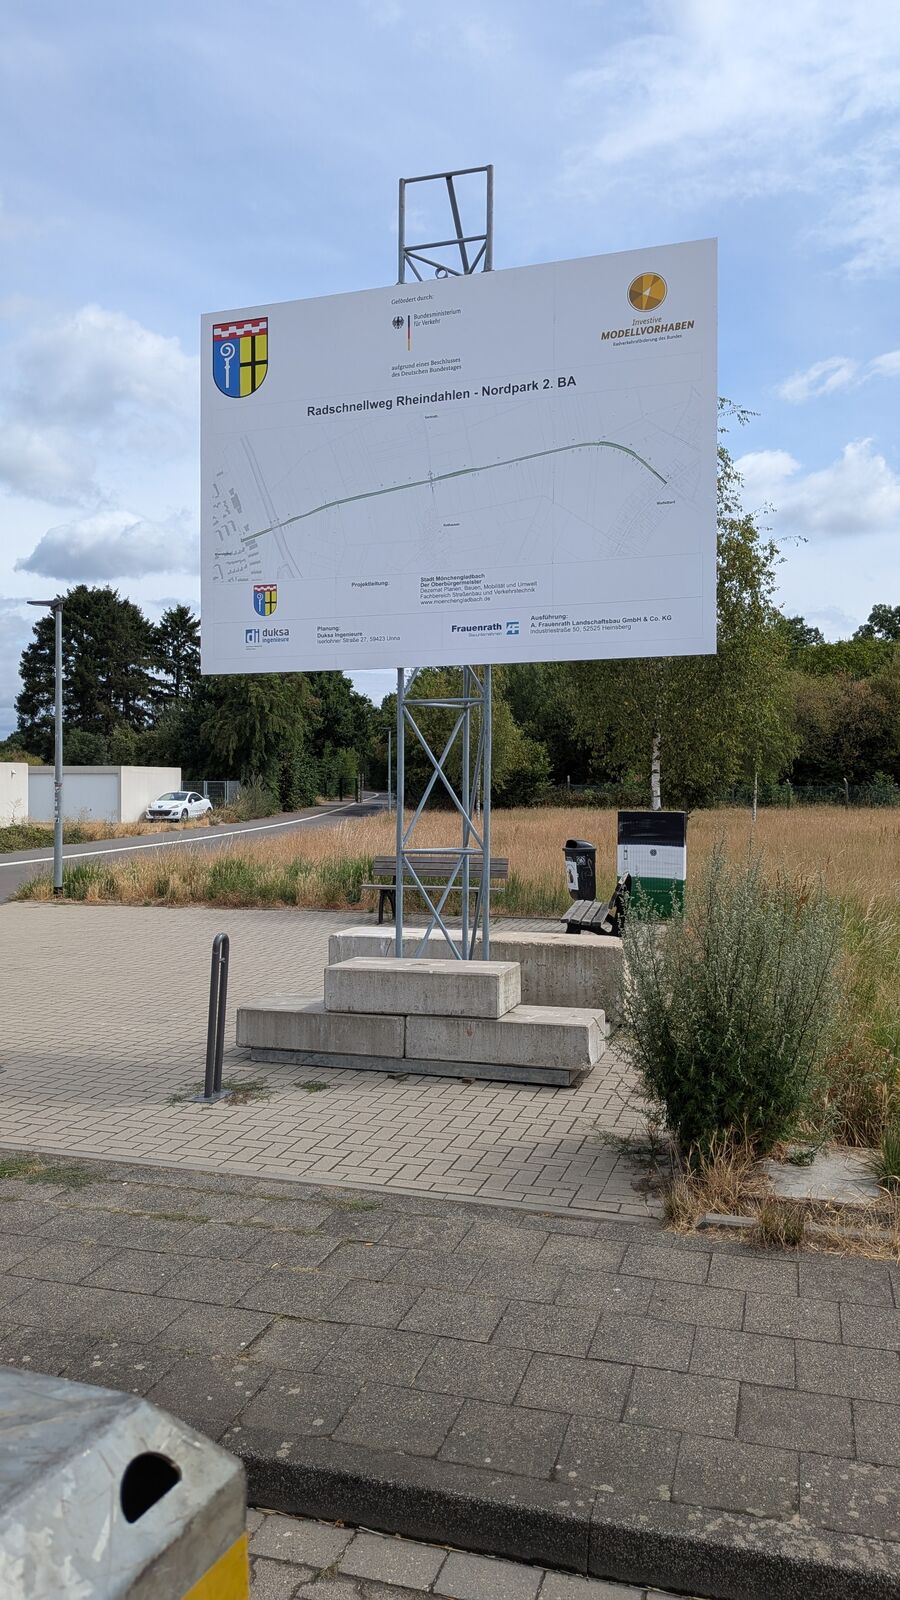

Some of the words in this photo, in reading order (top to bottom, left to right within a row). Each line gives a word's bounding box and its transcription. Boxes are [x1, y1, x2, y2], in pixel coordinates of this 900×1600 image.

[391, 297, 416, 305] Gefördert
[413, 309, 461, 320] Bundesministerium
[632, 316, 662, 326] Investive
[601, 320, 695, 340] MODELLVORHABEN
[391, 362, 416, 371] aufgrund
[430, 358, 461, 366] Beschlusses
[400, 367, 429, 376] Deutschen
[429, 364, 462, 373] Bundestages
[307, 399, 393, 416] Radschnellweg
[396, 390, 470, 406] Rheindahlen
[481, 380, 539, 396] Nordpark
[542, 378, 553, 390] 2.
[557, 375, 577, 388] BA
[435, 574, 485, 582] Mönchengladbach
[430, 579, 482, 588] Oberbürgermeister
[517, 580, 537, 588] Umwelt
[420, 592, 451, 600] Fachbereich
[494, 587, 535, 595] Verkehrstechnik
[420, 597, 491, 605] www.moenchengladbach.de
[451, 623, 502, 633] Frauenrath
[538, 620, 571, 628] Frauenrath
[572, 618, 621, 626] Landschaftsbau
[262, 627, 289, 637] duksa
